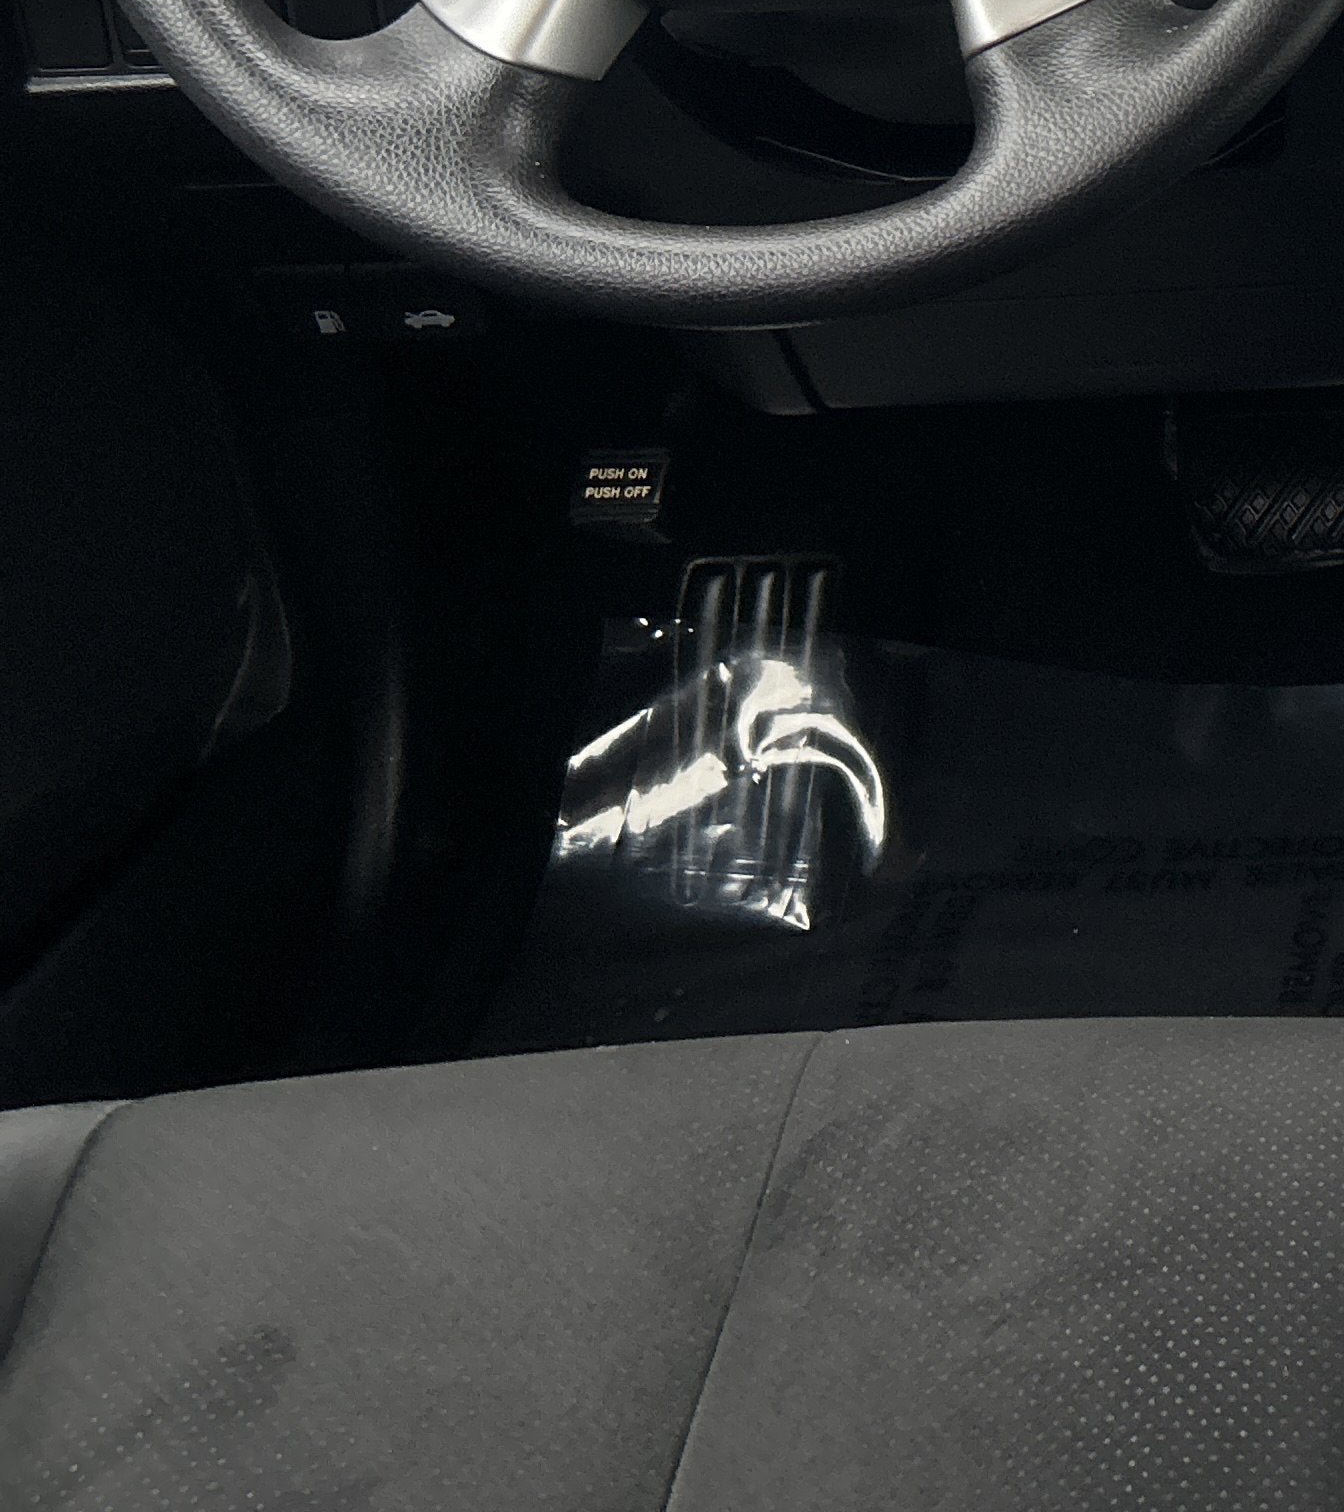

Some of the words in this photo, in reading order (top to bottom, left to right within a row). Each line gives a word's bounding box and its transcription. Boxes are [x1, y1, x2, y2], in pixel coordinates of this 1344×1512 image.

[589, 468, 625, 480] PUSH
[628, 468, 648, 479] ON
[584, 487, 621, 499] PUSH
[624, 486, 651, 498] OFF
